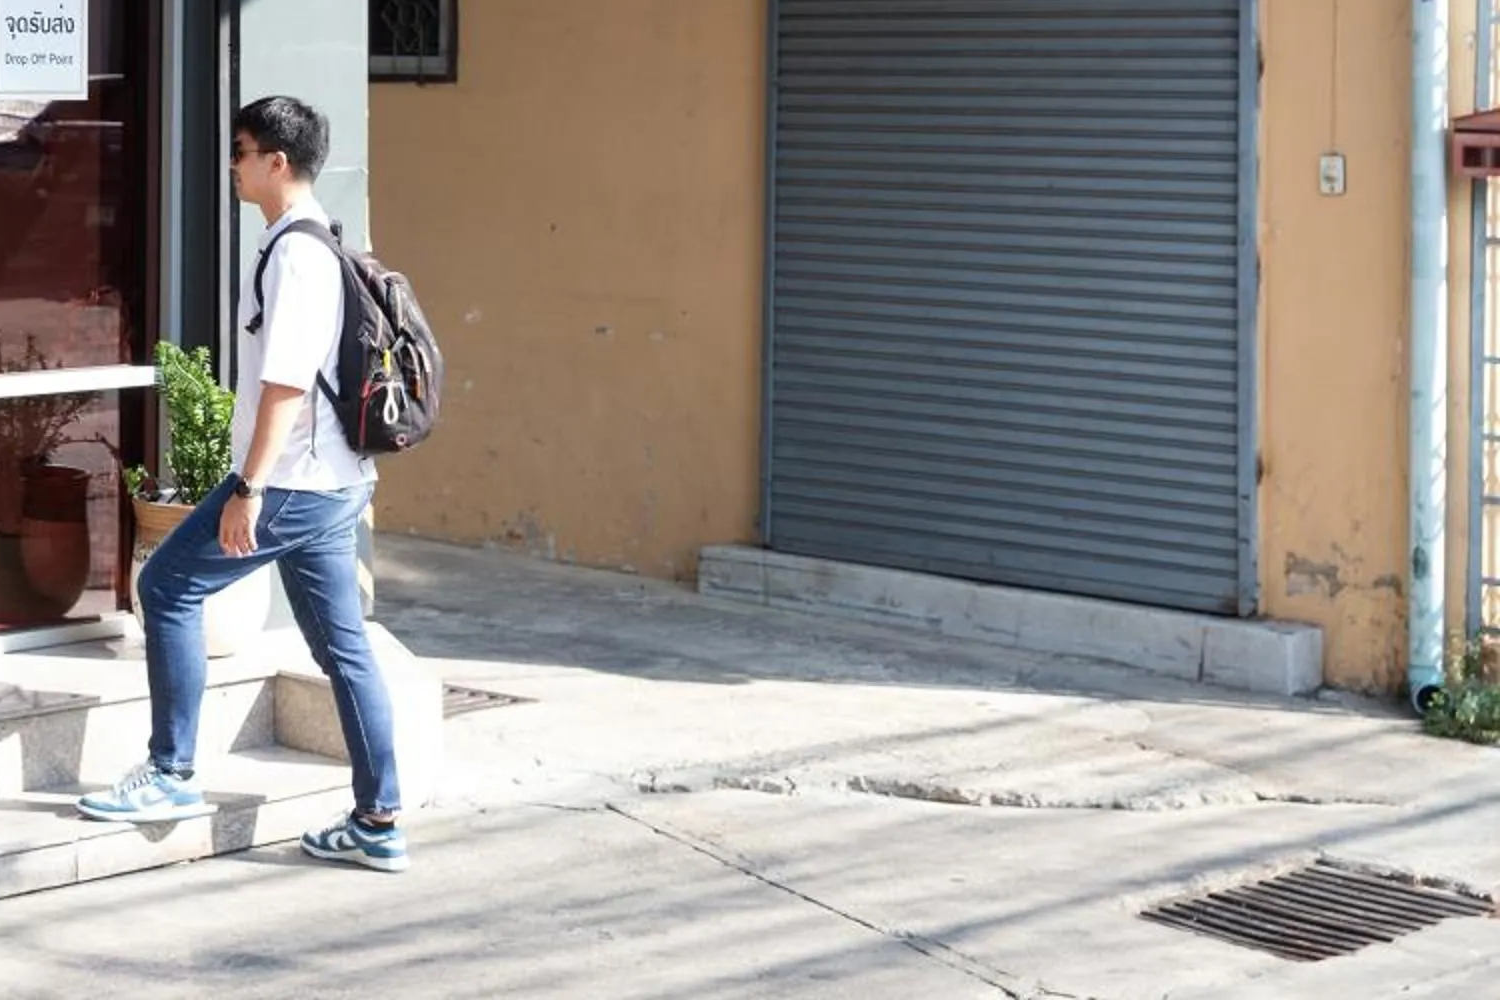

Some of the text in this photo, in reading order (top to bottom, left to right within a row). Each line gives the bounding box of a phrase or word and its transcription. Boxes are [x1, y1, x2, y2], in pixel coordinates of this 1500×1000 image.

[5, 3, 75, 40] จุดรับส่ง
[5, 53, 28, 67] Drop
